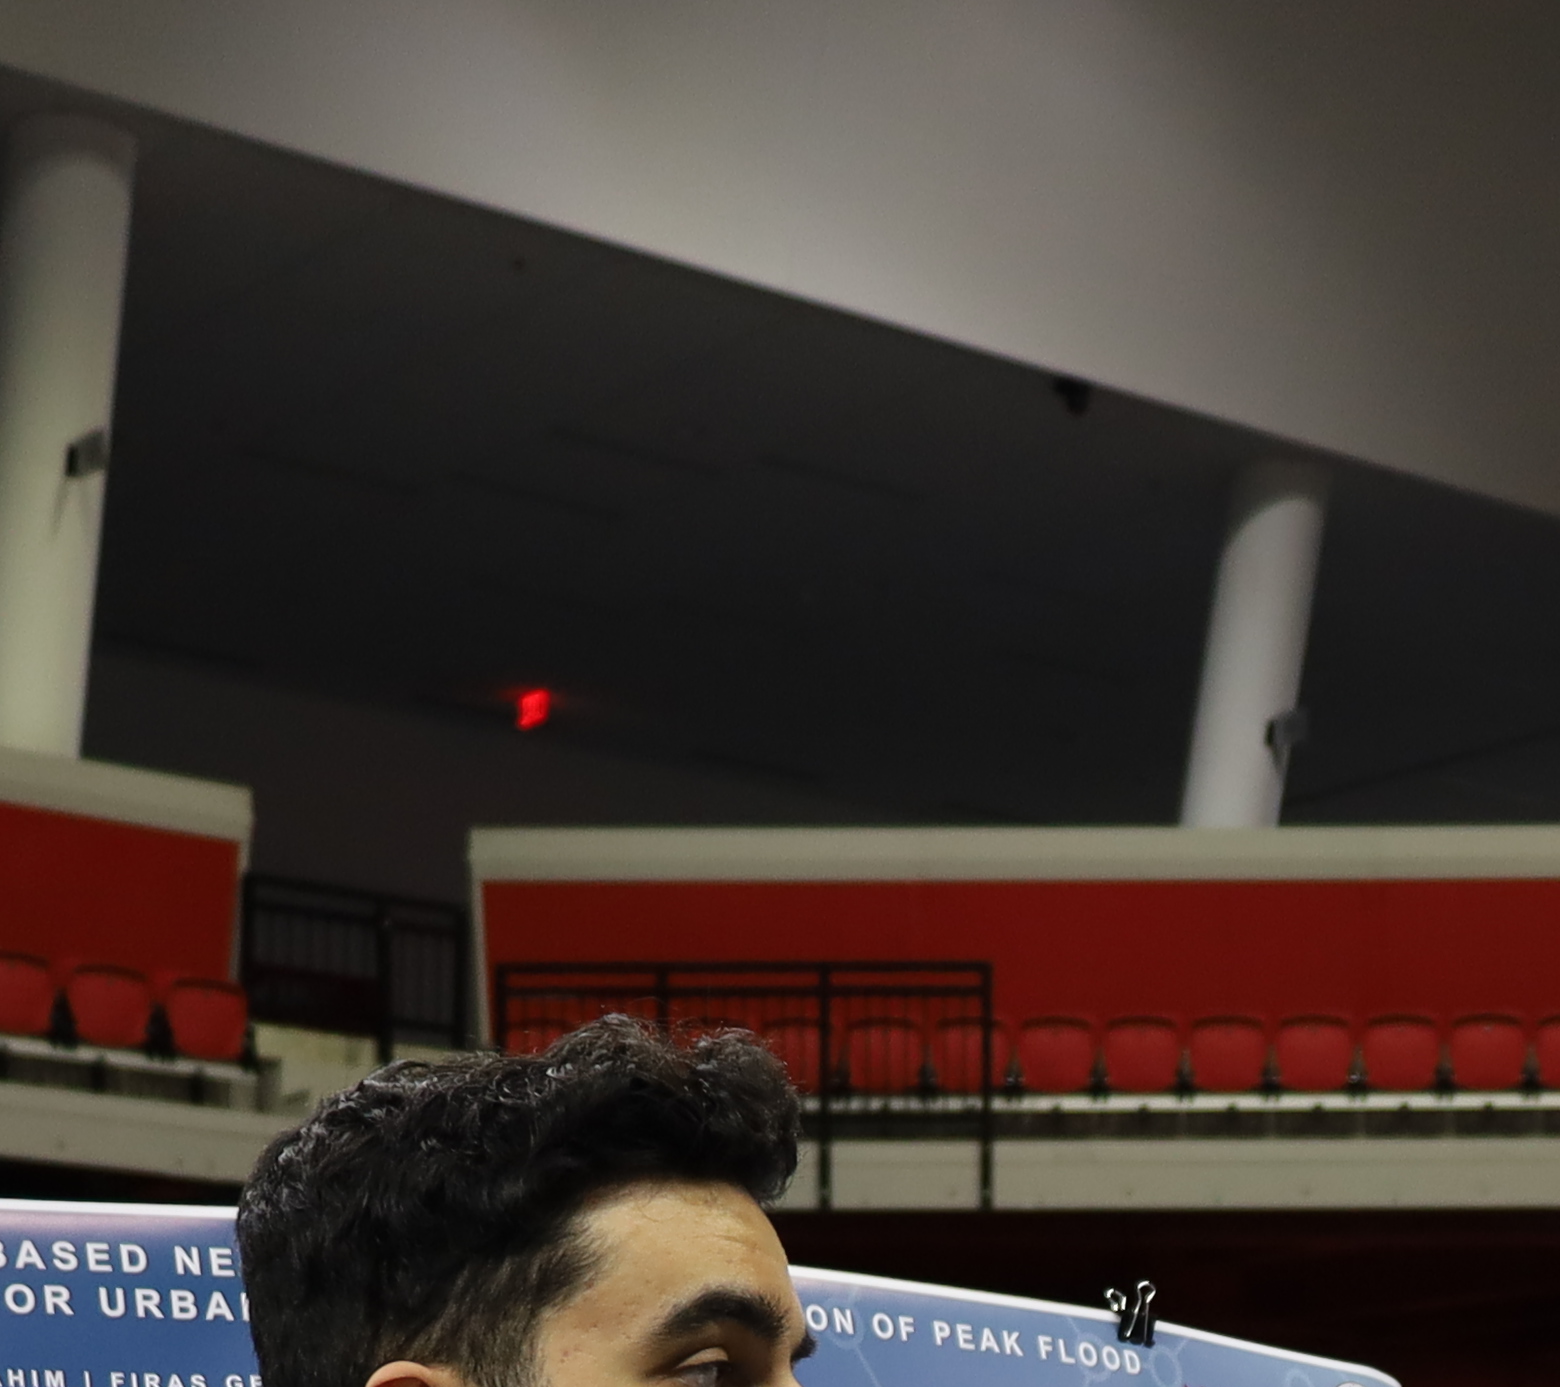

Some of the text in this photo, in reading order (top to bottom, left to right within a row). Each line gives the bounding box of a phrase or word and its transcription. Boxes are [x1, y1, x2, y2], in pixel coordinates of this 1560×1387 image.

[872, 1313, 915, 1341] OF
[933, 1320, 1024, 1357] PEAK
[1039, 1336, 1141, 1375] FLOOD
